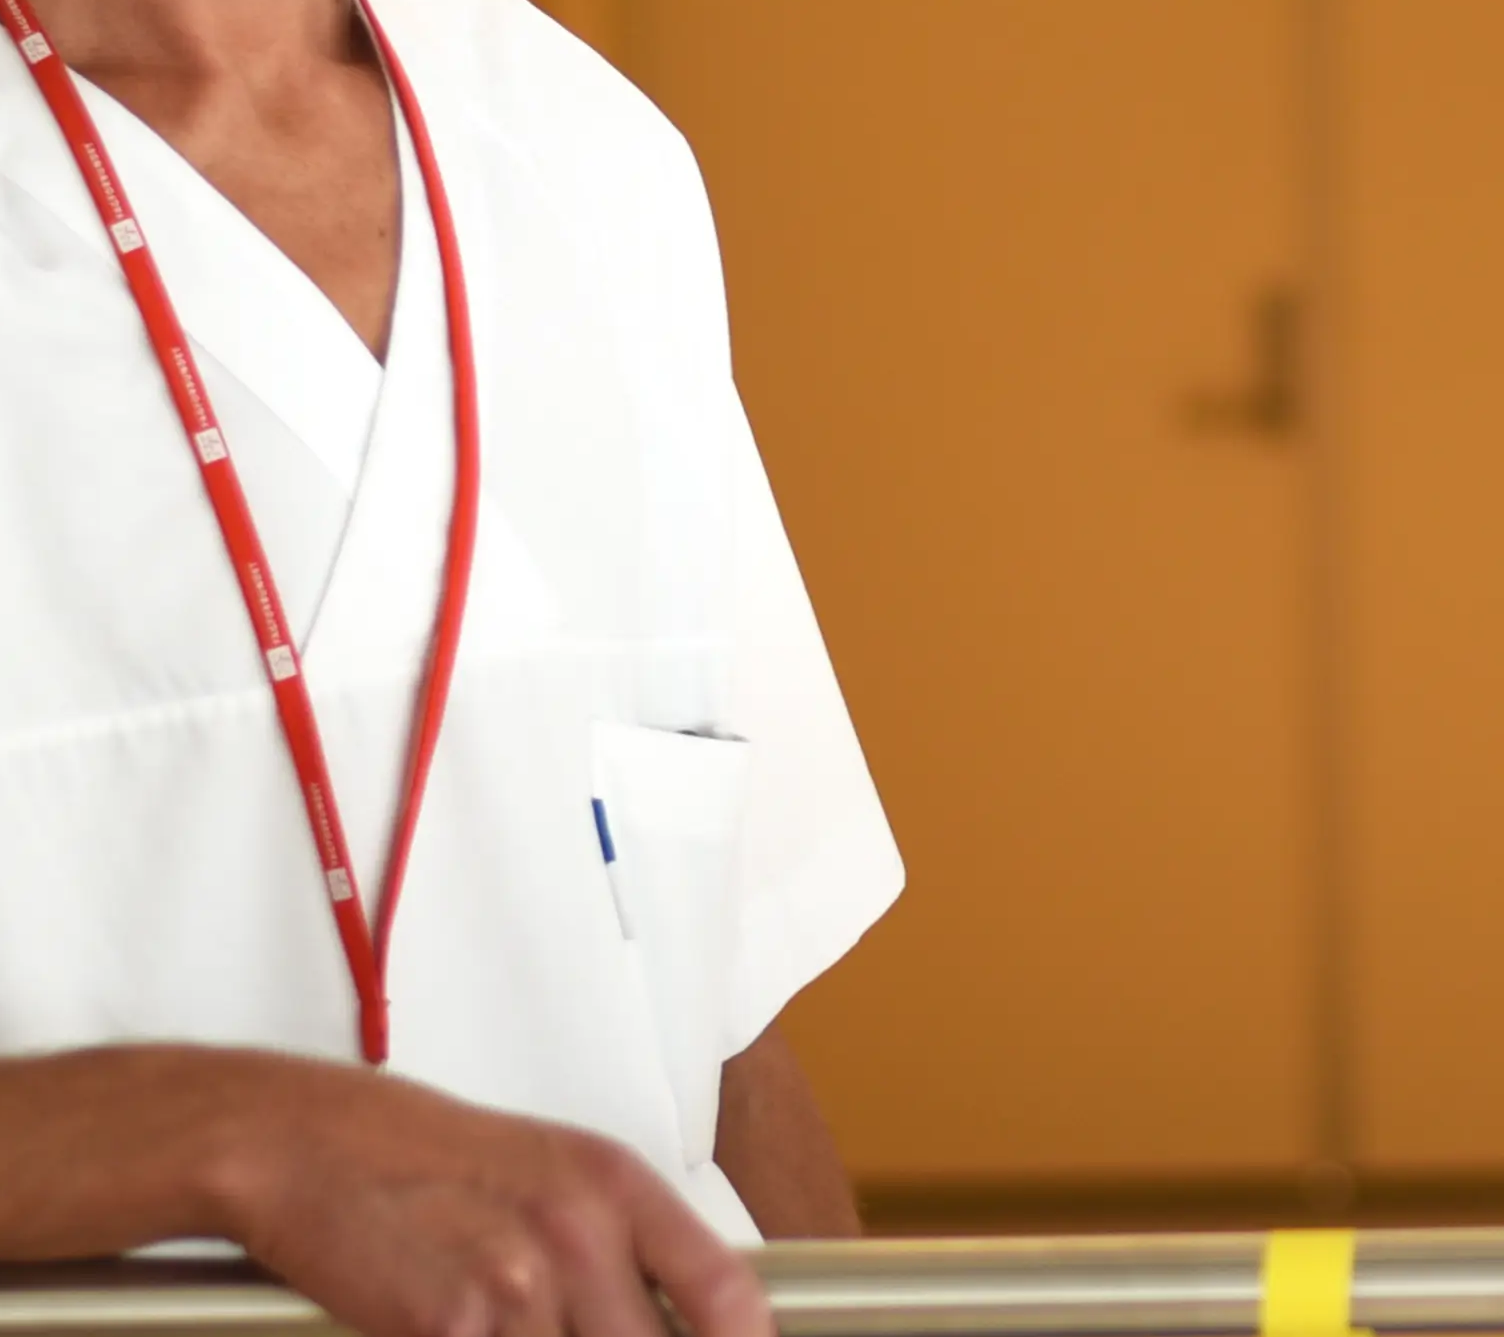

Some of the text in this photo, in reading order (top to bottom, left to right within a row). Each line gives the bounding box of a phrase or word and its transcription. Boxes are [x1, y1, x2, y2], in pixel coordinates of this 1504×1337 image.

[84, 142, 124, 219] FAGFORBUNDET
[172, 346, 209, 428] FAGFORBUNDET
[249, 562, 282, 645] FAGFORBUNDET
